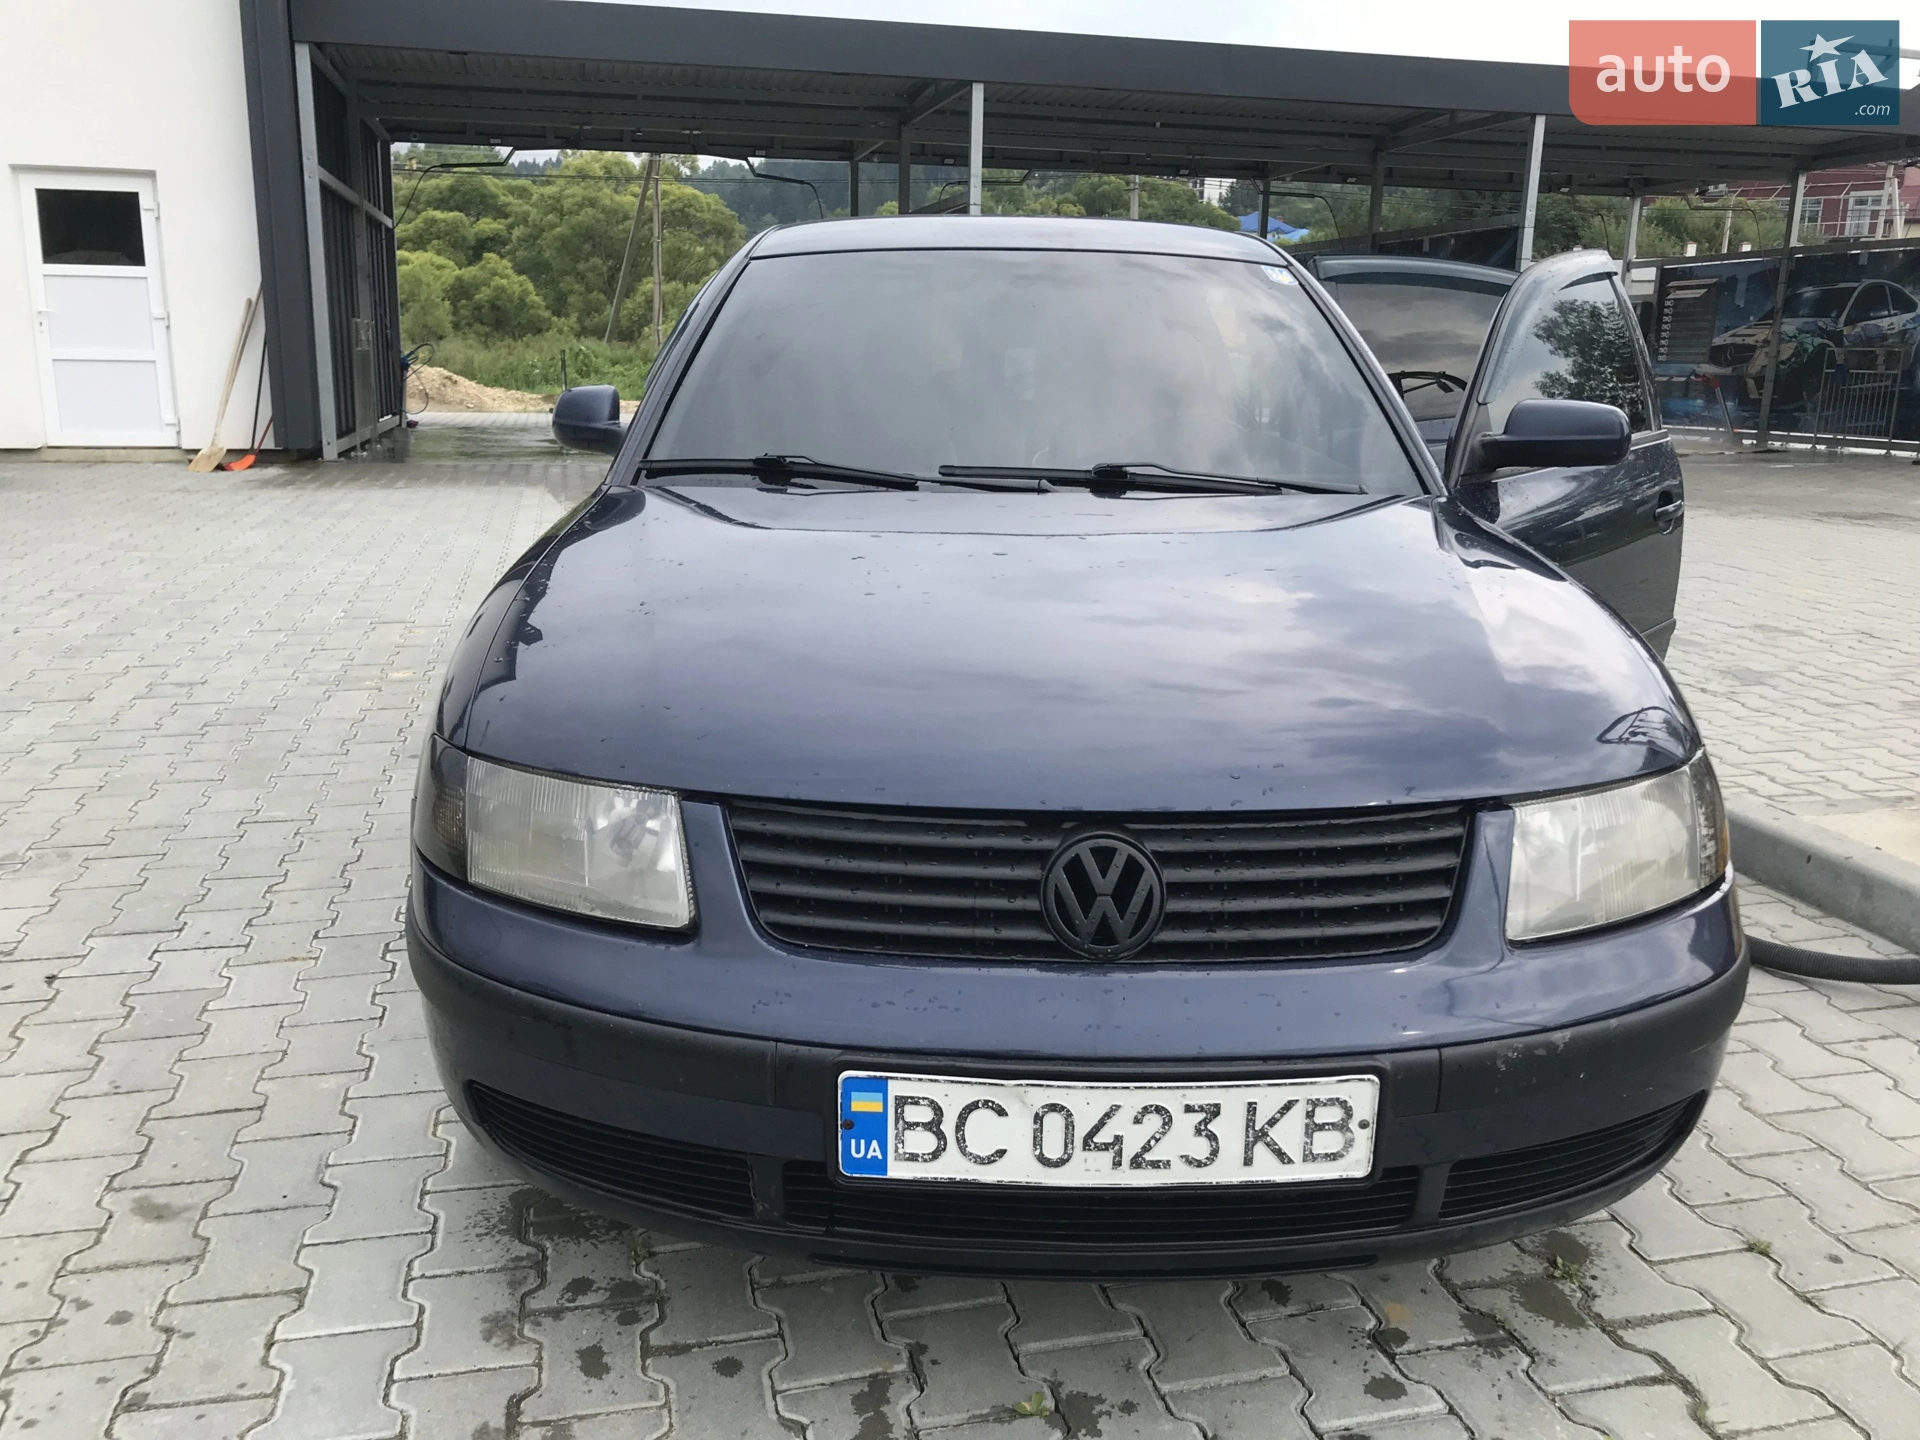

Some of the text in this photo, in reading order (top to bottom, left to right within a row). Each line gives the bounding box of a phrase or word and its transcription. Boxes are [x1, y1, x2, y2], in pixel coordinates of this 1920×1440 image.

[850, 1138, 883, 1160] UA
[894, 1095, 1355, 1169] BC 0423 KB
